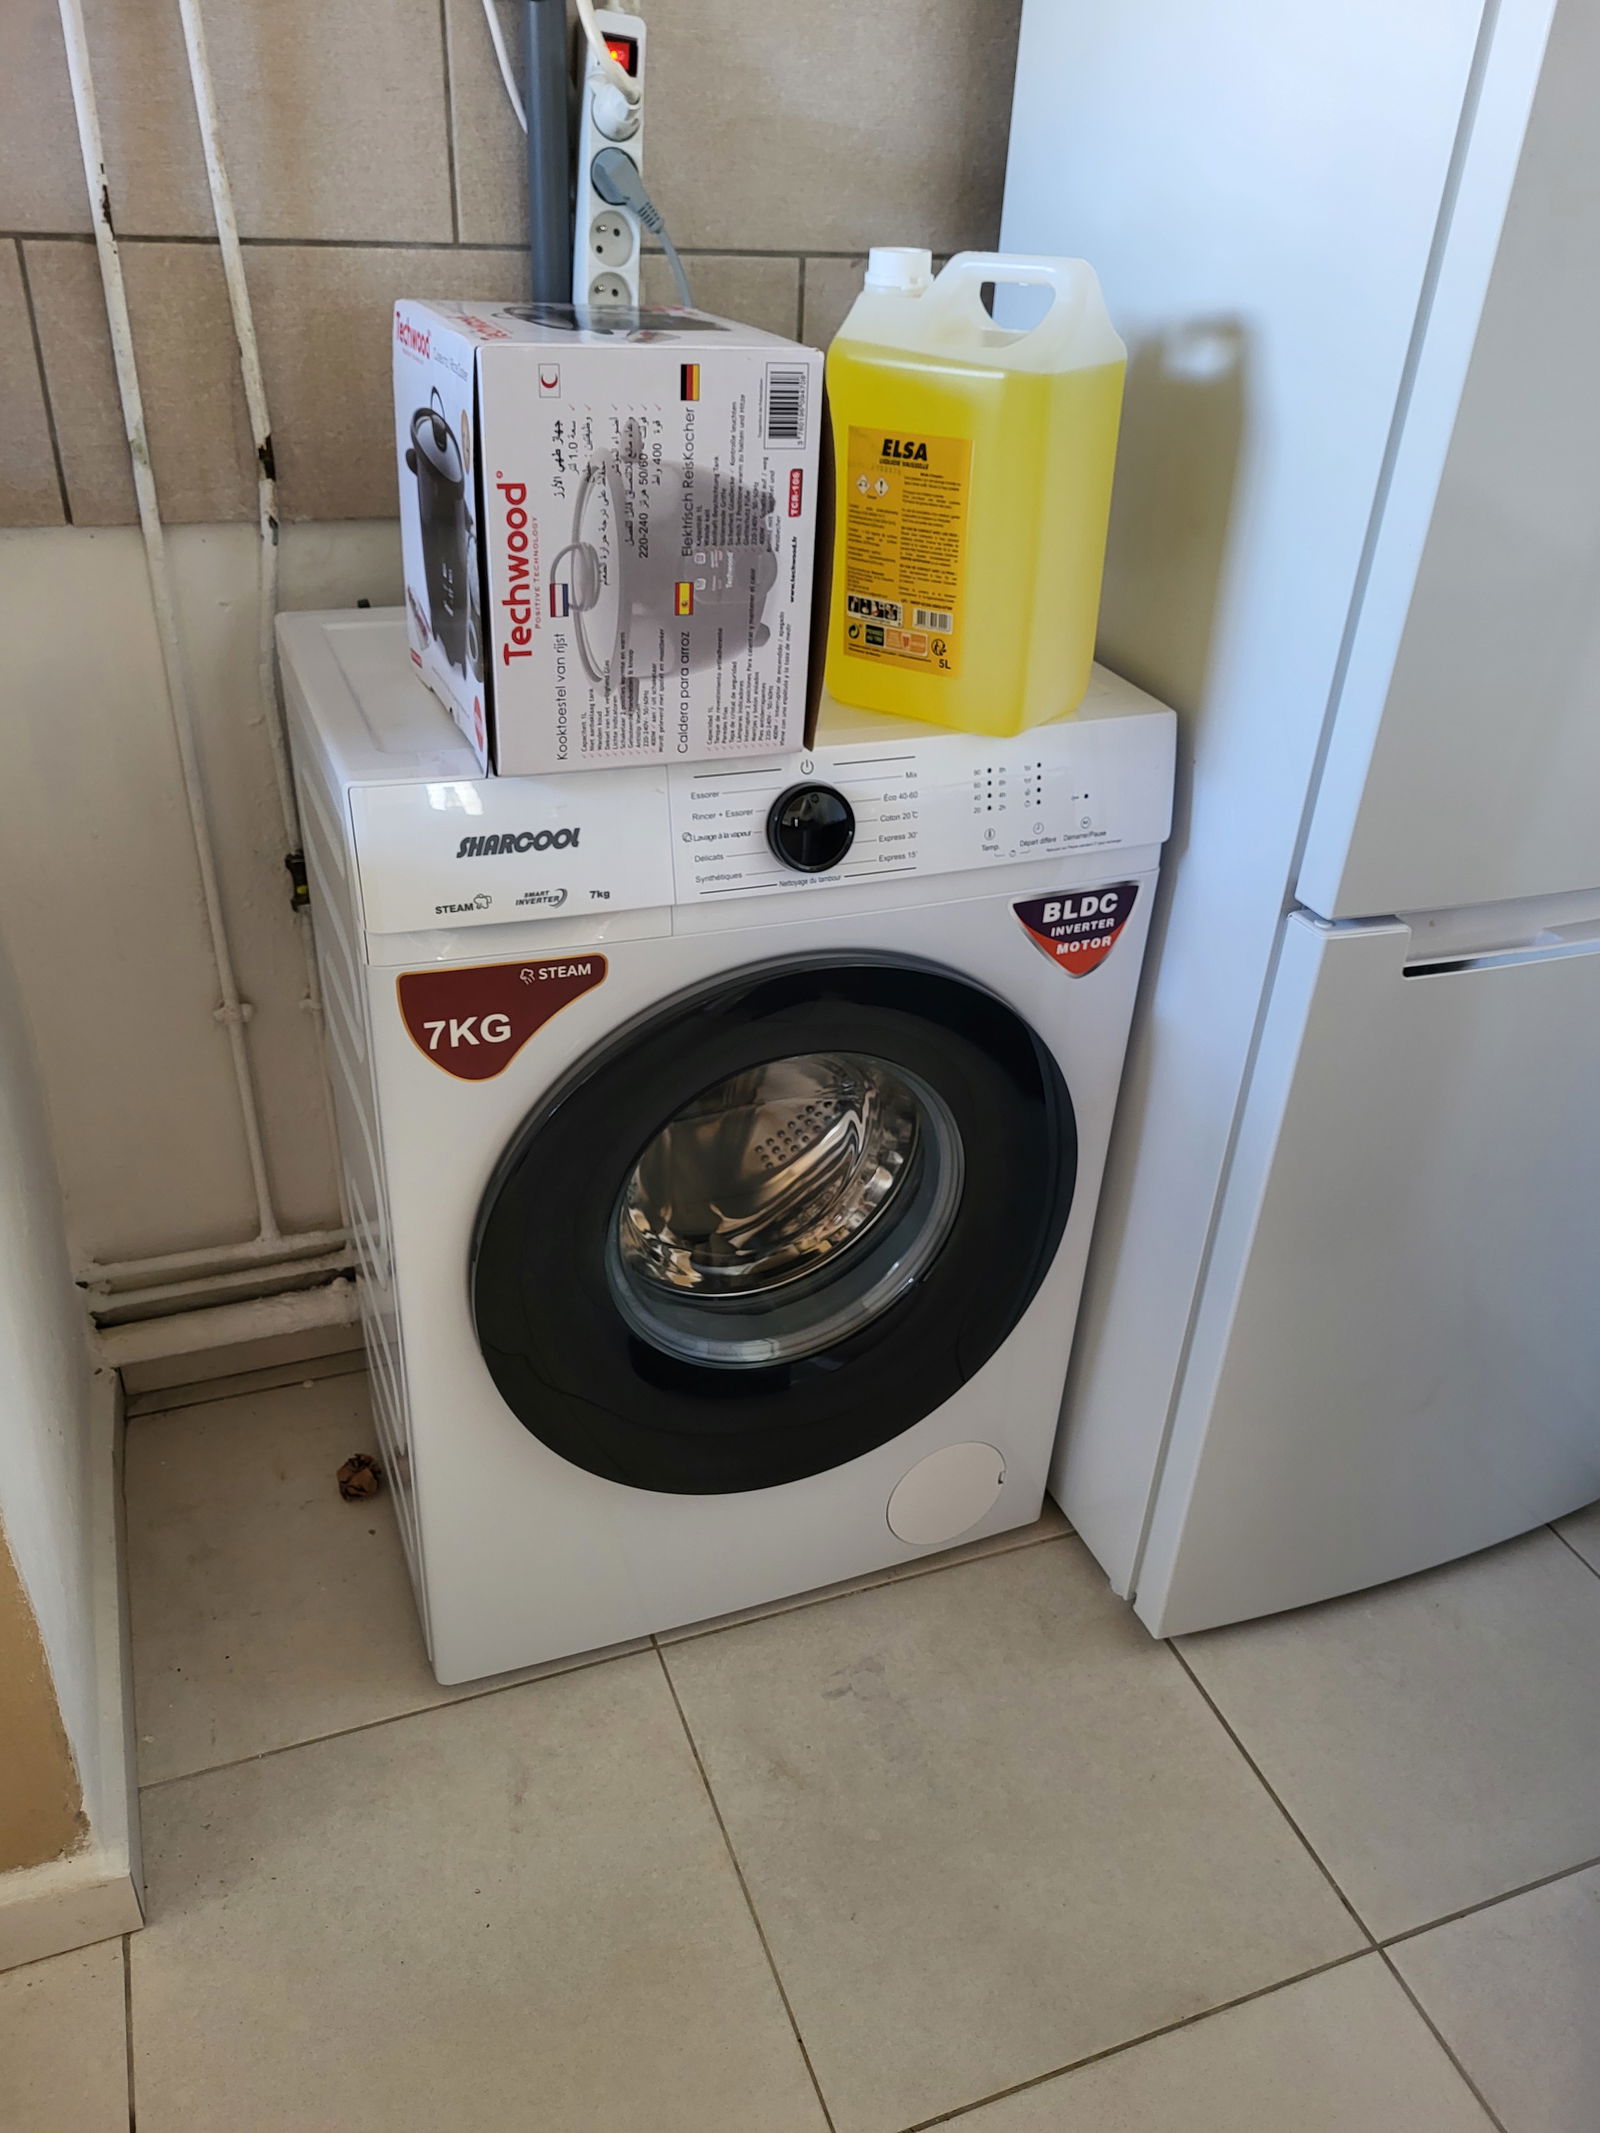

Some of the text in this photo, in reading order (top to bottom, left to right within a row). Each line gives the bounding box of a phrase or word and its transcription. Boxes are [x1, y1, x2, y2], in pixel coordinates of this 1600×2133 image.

[568, 442, 578, 459] 1.0
[652, 443, 662, 465] 400
[882, 438, 928, 461] ELSA
[638, 453, 649, 485] 50/60
[681, 407, 695, 557] Elektrisch ReisKocher
[638, 513, 649, 558] 220-240
[496, 482, 532, 666] Techwood
[532, 517, 542, 629] POSITIVE TECHNOLOGY
[938, 659, 951, 670] 5L
[553, 634, 568, 760] Kooktoestel van rijst
[677, 631, 691, 753] Caldera para arroz
[690, 791, 720, 800] Essorer
[899, 791, 918, 799] 40-60
[692, 812, 716, 821] Rincer
[725, 808, 754, 818] Essorer
[456, 827, 580, 859] SHARCOOL
[693, 833, 718, 843] Lavage
[729, 830, 752, 840] vapeur
[878, 834, 906, 843] Express
[878, 854, 906, 862] Express
[515, 895, 560, 906] INVERTER
[524, 890, 550, 898] SMART
[589, 890, 610, 900] 7kg
[435, 902, 474, 915] STEAM
[1042, 892, 1119, 924] BLDC
[1050, 917, 1115, 937] INVERTER
[1056, 935, 1112, 955] MOTOR
[538, 963, 592, 980] STEAM
[423, 1013, 512, 1050] 7KG
